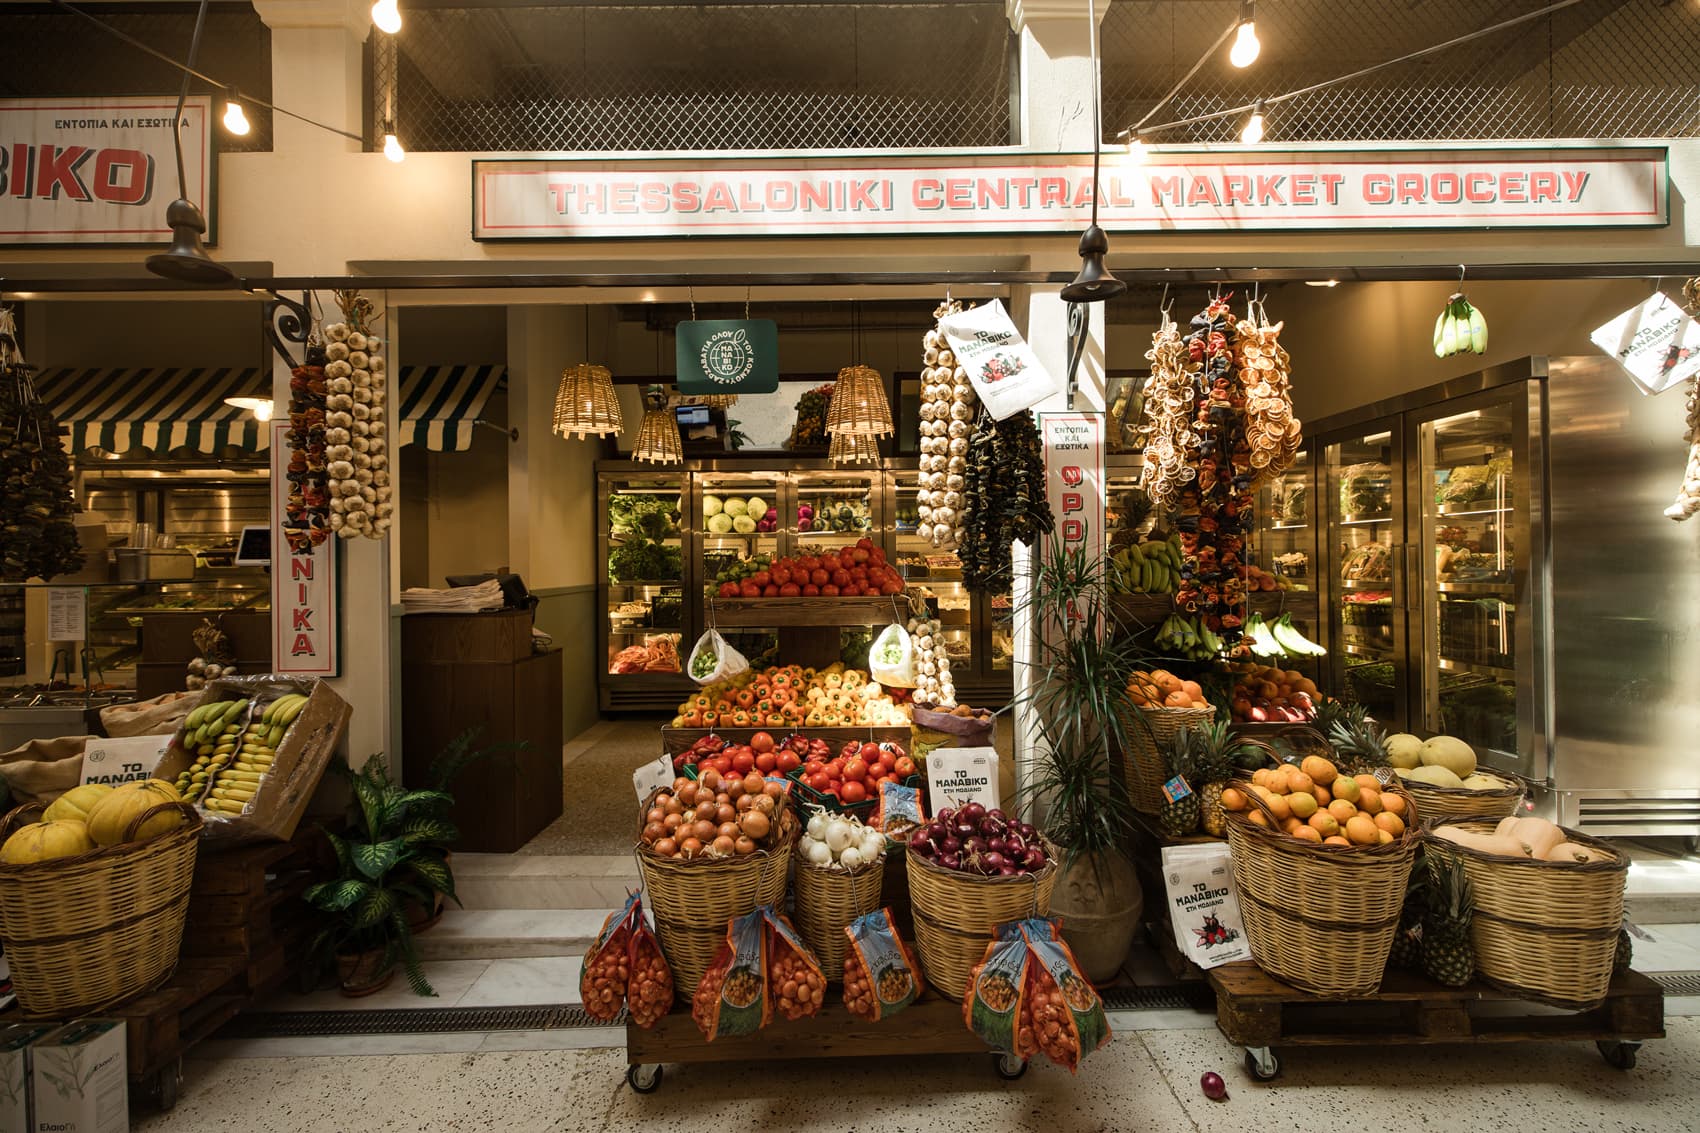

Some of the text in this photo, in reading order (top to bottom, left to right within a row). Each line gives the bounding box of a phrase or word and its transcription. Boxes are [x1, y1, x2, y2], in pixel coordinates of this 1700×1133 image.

[55, 118, 190, 129] ΕΝΤΟΠΙΑ ΚΑΙ ΕΞΩΤΙΑ
[0, 143, 155, 206] ΙΚΟ
[549, 170, 1591, 215] THESSALONIKI CENTRAL MARKET GROCERY
[973, 330, 989, 340] ΤΟ
[1619, 318, 1681, 357] ΜΑΝΑΒΙΚΟ
[1635, 327, 1652, 338] ΤΟ
[743, 340, 754, 355] ΤΟΥ
[958, 330, 1013, 354] ΜΑΝΑΒΙΚΟ
[1054, 426, 1089, 434] ΕΝΤΟΠΙΑ
[122, 763, 143, 773] ΤΟ
[954, 770, 968, 778] ΤΟ
[936, 777, 988, 788] ΜΑΝΑΒΙΚΟ
[1192, 883, 1207, 892] ΤΟ
[1176, 887, 1229, 907] ΜΑΝΑΒΙΚΟ
[1198, 899, 1224, 910] ΜΟΔΙΑΝΟ
